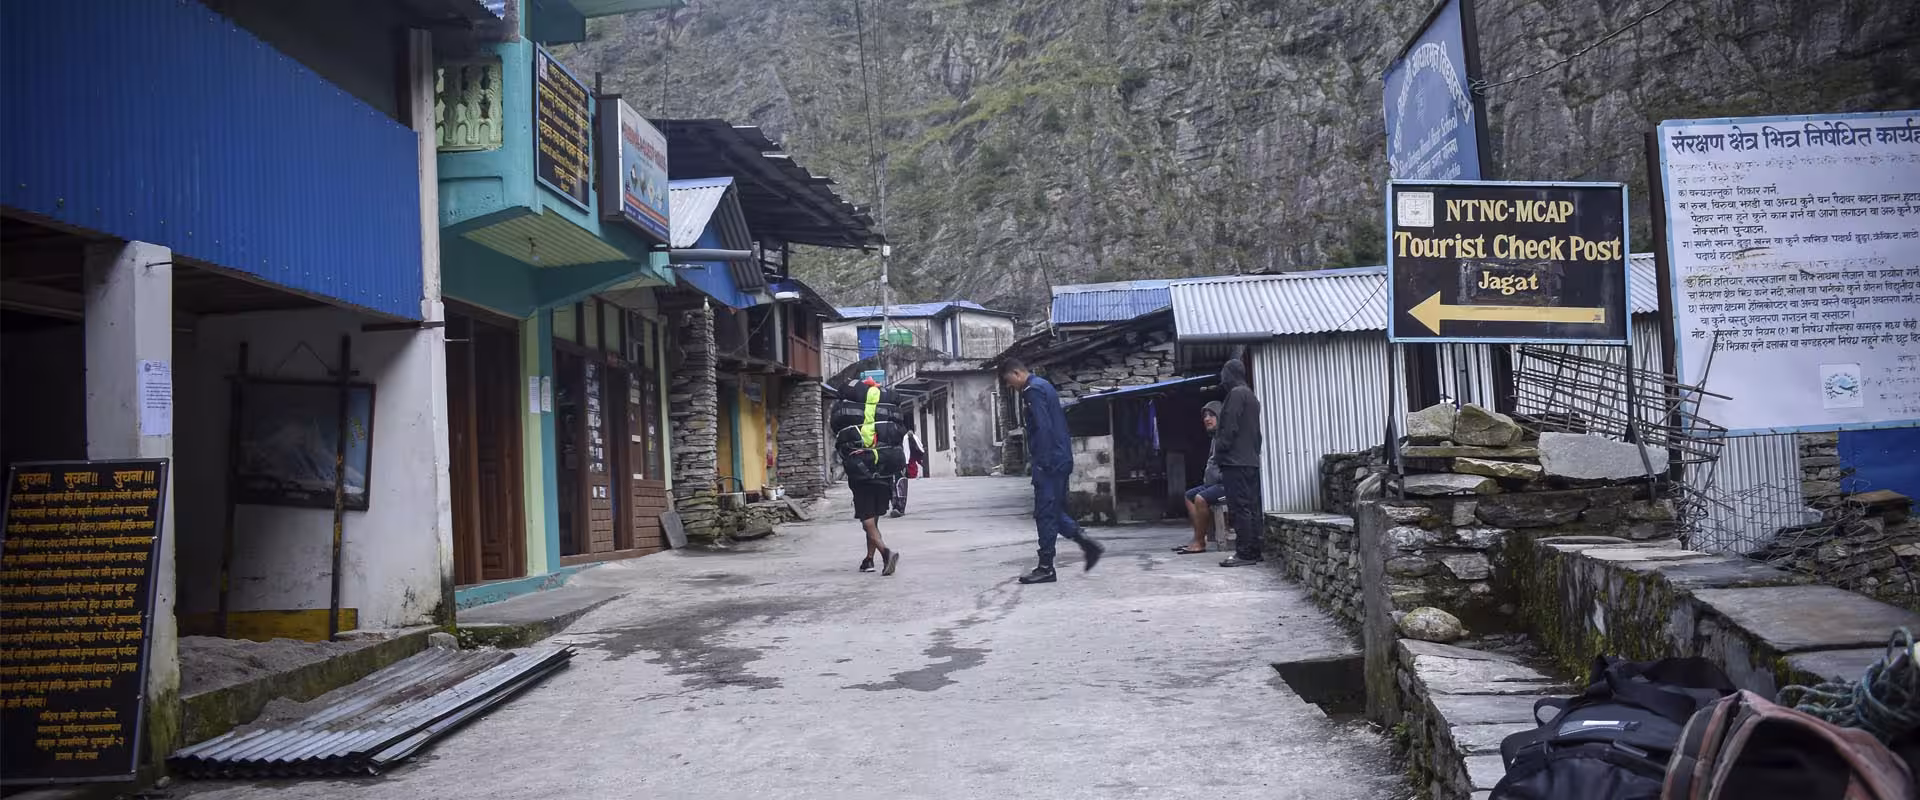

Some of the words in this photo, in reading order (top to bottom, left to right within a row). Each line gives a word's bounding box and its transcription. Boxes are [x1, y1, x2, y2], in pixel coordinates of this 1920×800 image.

[1412, 43, 1440, 77] आधारभूत
[1440, 40, 1474, 125] विद्यालय
[1441, 106, 1458, 137] School
[1671, 130, 1725, 154] संरक्षण
[1728, 125, 1758, 152] क्षेत्र
[1762, 126, 1801, 149] भित्र
[1803, 121, 1872, 147] निषेधित
[1689, 185, 1733, 199] वन्यजन्तुको
[1736, 185, 1760, 196] शिकार
[1764, 200, 1773, 208] वा
[1776, 198, 1797, 208] अन्य
[1800, 193, 1814, 209] कुनै
[1817, 196, 1830, 204] वन
[1832, 192, 1855, 204] पैदावर
[1445, 199, 1574, 223] NTNC-MCAP
[1690, 211, 1713, 224] पैदावर
[1716, 212, 1732, 222] नास
[1736, 210, 1748, 225] हुने
[1752, 209, 1766, 224] कुनै
[1770, 211, 1788, 221] काम
[1790, 207, 1804, 219] गर्न
[1806, 209, 1816, 218] वा
[1818, 206, 1838, 218] आगो
[1840, 208, 1867, 217] लगाउन
[1870, 207, 1879, 216] वा
[1881, 207, 1896, 216] अरु
[1692, 224, 1728, 235] नोक्सानी
[1694, 239, 1712, 250] खानी
[1754, 238, 1772, 247] खन्न
[1786, 232, 1800, 248] कुनै
[1802, 234, 1828, 244] खनिज
[1832, 232, 1852, 242] पदार्थ
[1902, 228, 1919, 238] माटो
[1394, 231, 1485, 259] Tourist
[1493, 234, 1566, 261] Check
[1569, 236, 1622, 261] Post
[1696, 250, 1716, 261] पदार्थ
[1478, 271, 1539, 295] Jagat
[1746, 274, 1786, 284] खरखजाना
[1788, 274, 1798, 282] वा
[1816, 272, 1840, 280] साथमा
[1867, 270, 1876, 278] वा
[1880, 266, 1904, 278] प्रयोग
[1699, 288, 1722, 300] संरक्षण
[1724, 288, 1736, 298] क्षेत्र
[1738, 288, 1752, 298] भित्र
[1786, 284, 1805, 296] खोला
[1808, 286, 1816, 294] वा
[1820, 282, 1844, 294] पानीको
[1846, 280, 1860, 295] कुनै
[1885, 280, 1914, 294] विद्युतीय
[1699, 302, 1723, 313] संरक्षण
[1724, 300, 1746, 312] क्षेत्रमा
[1790, 300, 1798, 308] वा
[1801, 299, 1818, 309] अन्य
[1821, 294, 1840, 307] यस्तै
[1842, 297, 1870, 308] वायुयान
[1872, 296, 1900, 305] अवतरण
[1700, 317, 1710, 326] वा
[1712, 314, 1726, 328] कुनै
[1728, 316, 1748, 328] वस्तु
[1748, 314, 1778, 325] अवतरण
[1782, 312, 1807, 322] गराउन
[1810, 312, 1819, 320] वा
[1822, 310, 1850, 320] खसाउन
[1742, 328, 1753, 338] उप
[1755, 326, 1776, 336] नियम
[1778, 328, 1789, 337] (१)
[1790, 326, 1800, 334] मा
[1802, 322, 1823, 334] निषेध
[1856, 322, 1882, 332] कामहरु
[1902, 318, 1918, 330] केही
[1726, 339, 1749, 352] भित्रका
[1766, 339, 1788, 349] इलाका
[1790, 338, 1798, 348] वा
[1800, 337, 1836, 348] खण्डहरुमा
[1838, 333, 1859, 346] निषेध
[1861, 332, 1878, 350] नहुने
[1881, 332, 1894, 343] गरि
[1896, 334, 1908, 346] छुट
